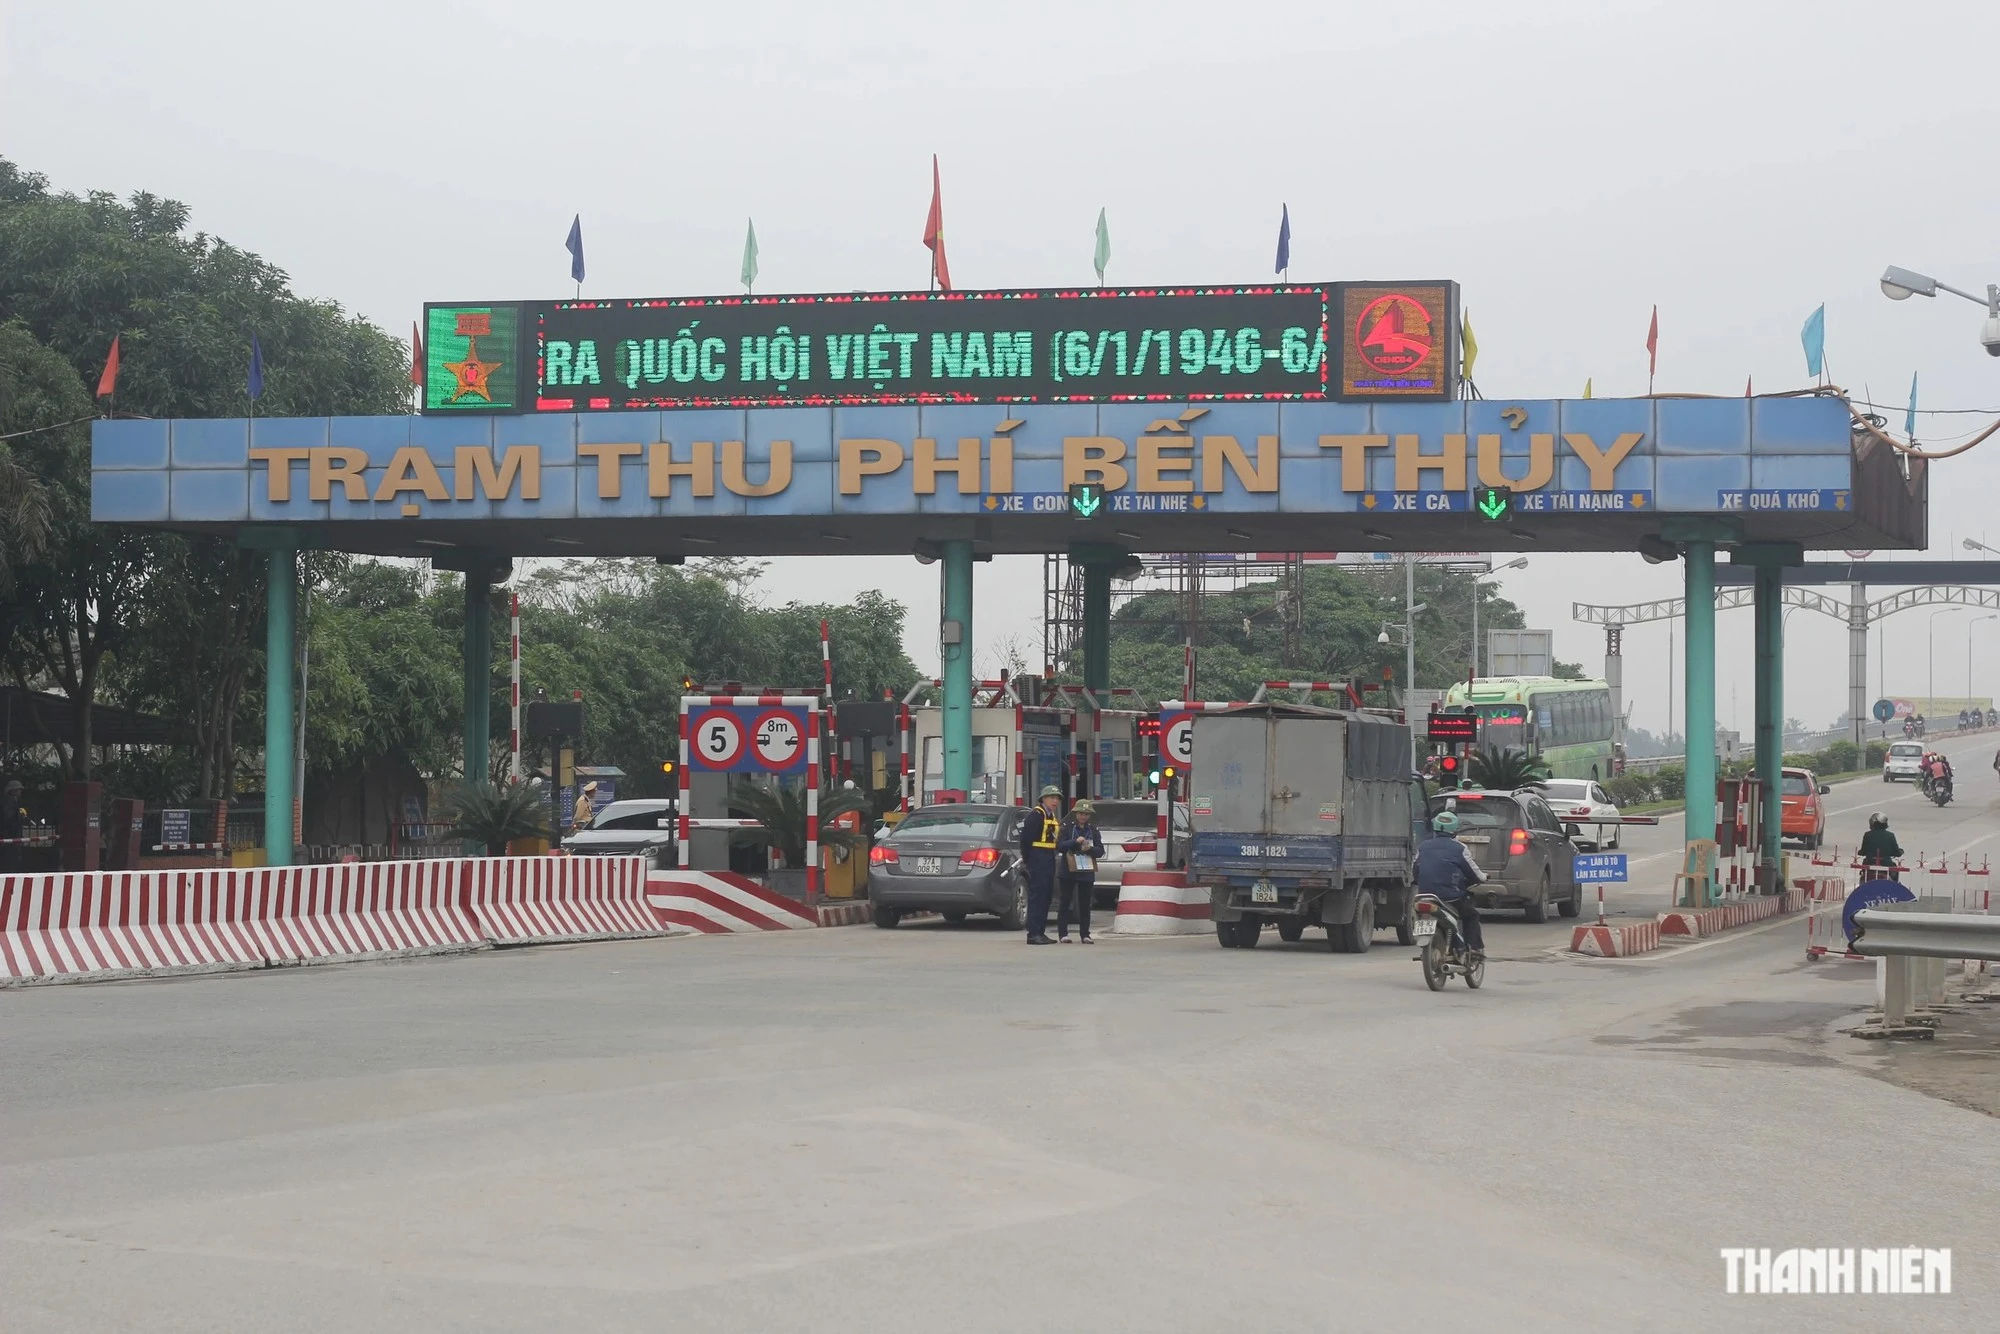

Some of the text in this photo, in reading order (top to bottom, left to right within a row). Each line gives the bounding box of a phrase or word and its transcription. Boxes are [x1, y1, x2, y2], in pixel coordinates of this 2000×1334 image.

[546, 340, 601, 385] RA
[615, 320, 726, 389] QUỐC
[740, 326, 811, 391] HỘI
[825, 323, 919, 390] VIỆT
[930, 330, 1033, 378] NAM
[249, 407, 1646, 517] TRẠM THU PHÍ BẾN THỦY
[1002, 495, 1069, 511] XE CON
[1113, 495, 1131, 511] XE
[1160, 494, 1188, 513] NHẸ
[1393, 494, 1417, 510] XE
[1523, 494, 1544, 510] XE
[1722, 486, 1821, 510] XE QUÁ KHỔ
[767, 720, 788, 732] 8m
[710, 727, 727, 753] 5
[1179, 730, 1192, 755] 5
